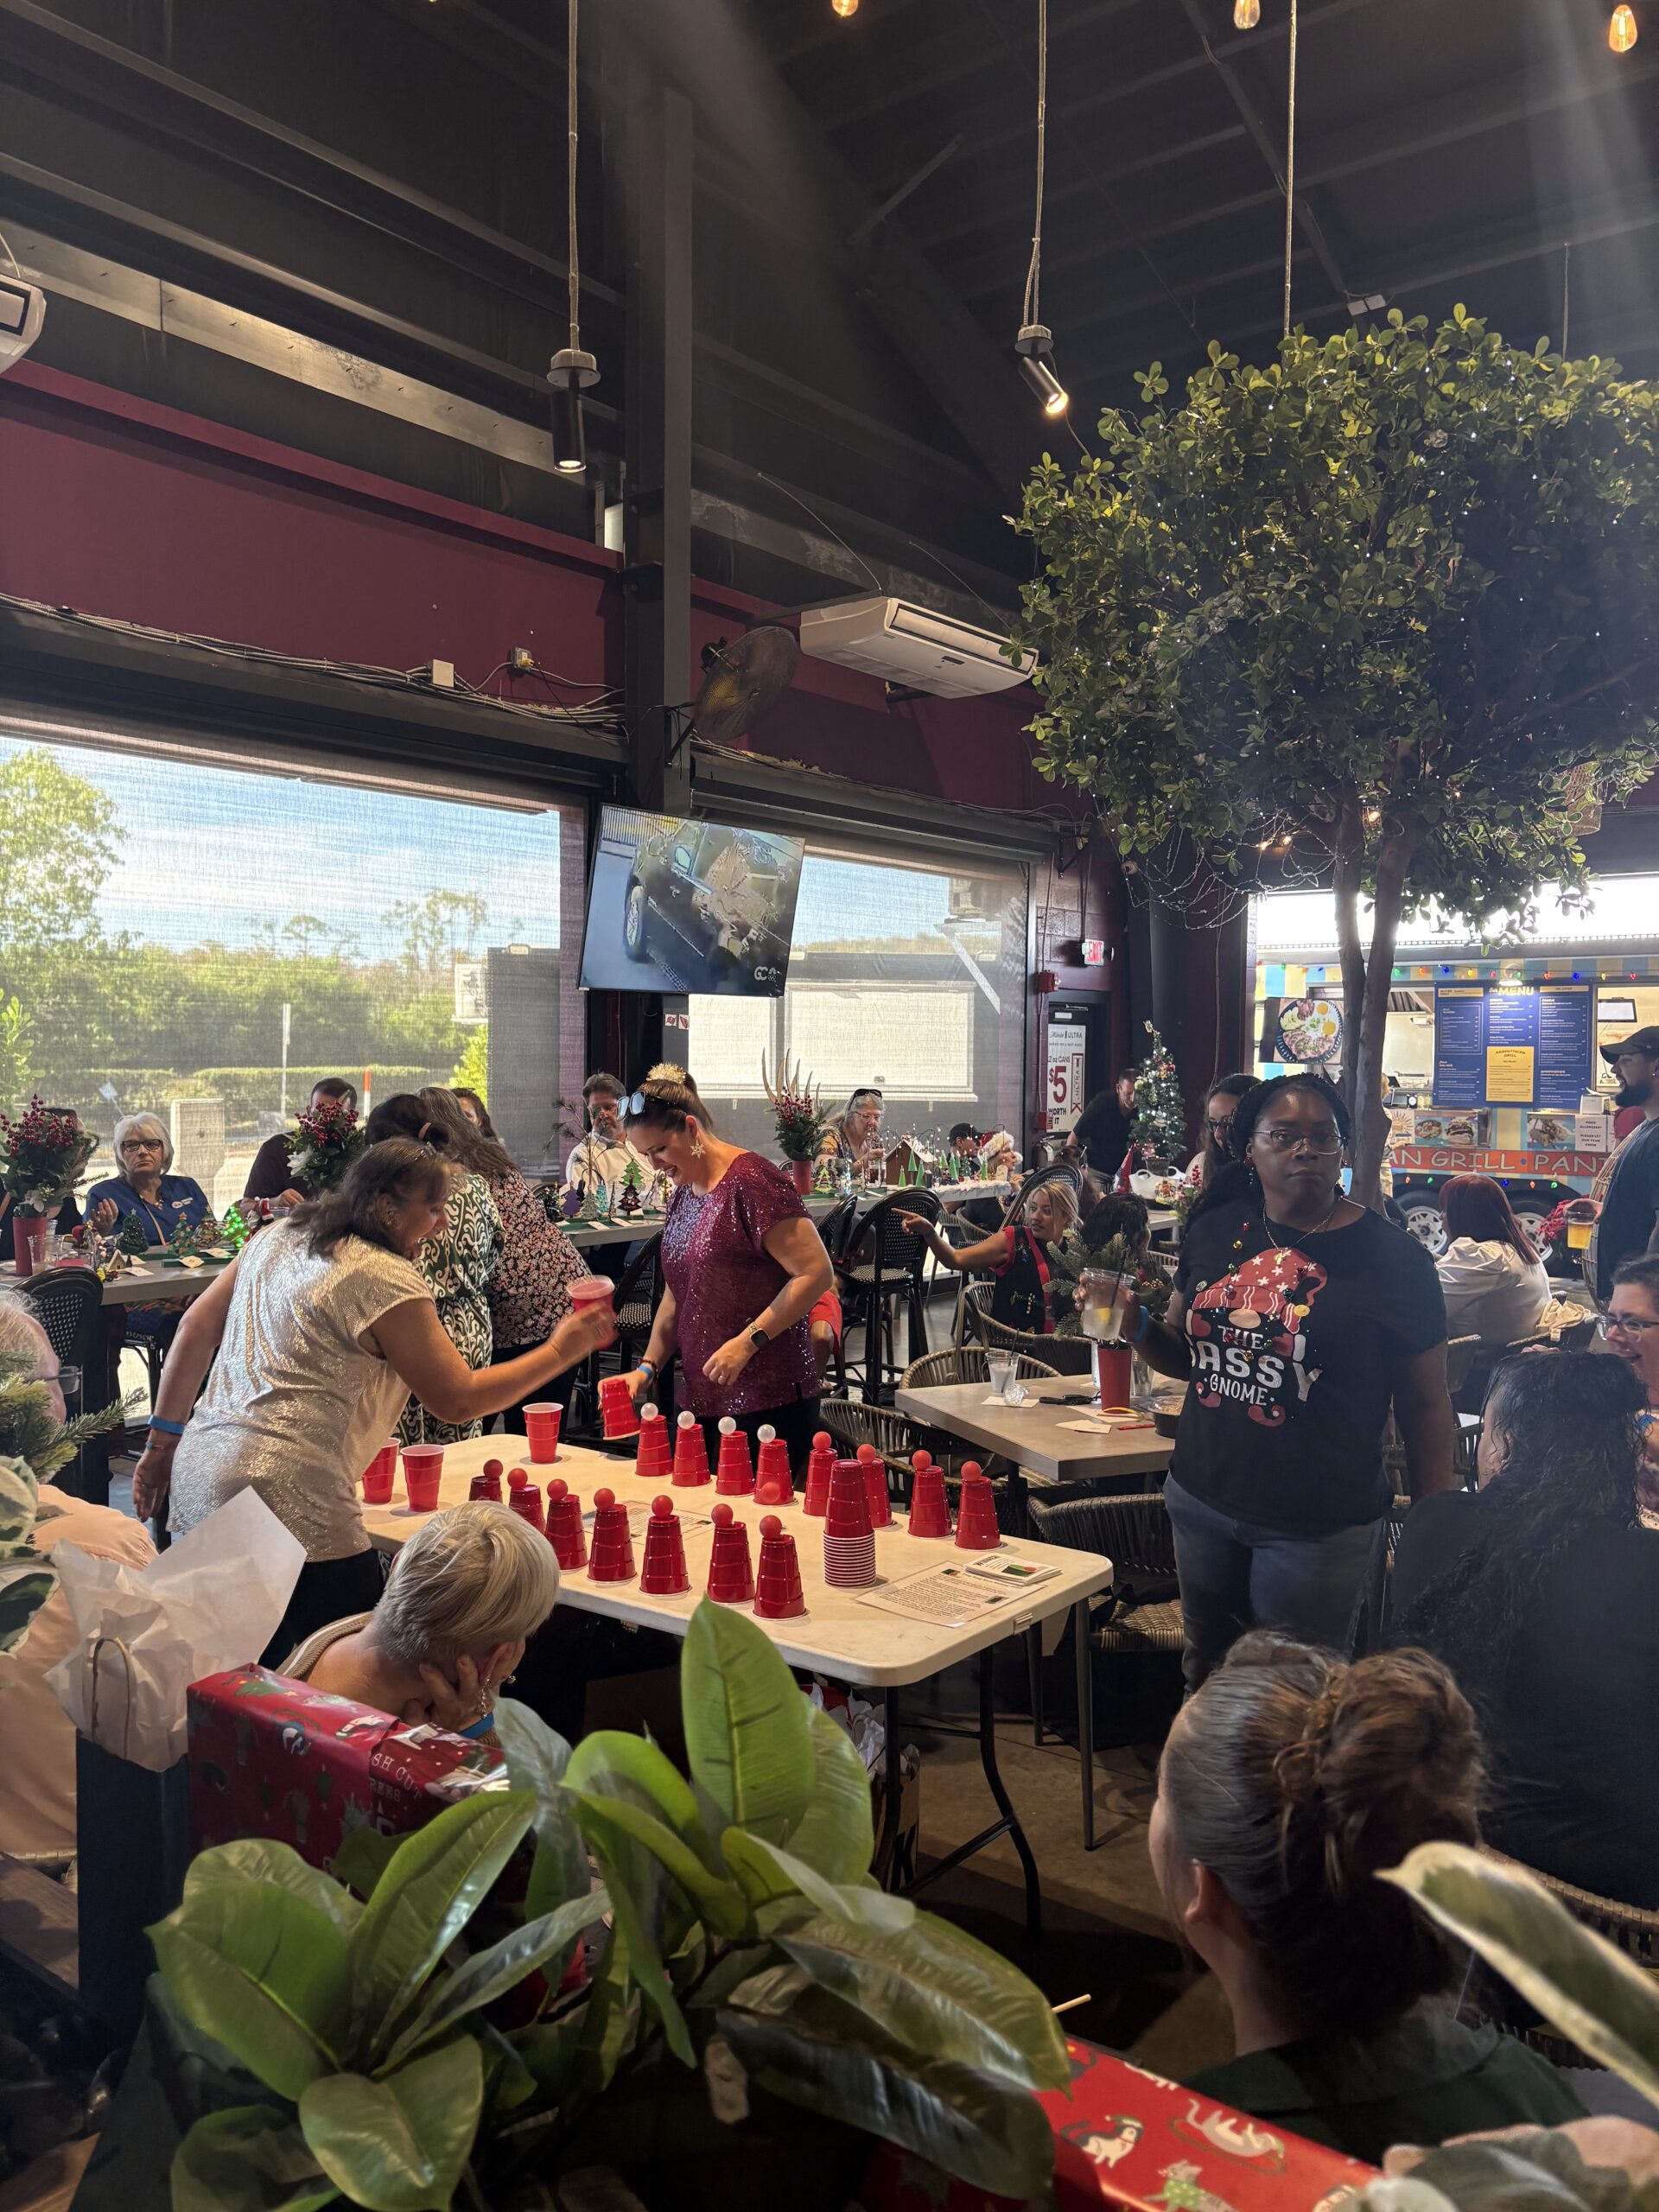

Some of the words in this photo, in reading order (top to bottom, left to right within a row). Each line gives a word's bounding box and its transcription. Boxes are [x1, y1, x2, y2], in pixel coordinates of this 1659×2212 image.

[1497, 986, 1534, 995] MENU
[1048, 1065, 1067, 1103] $5
[1431, 1150, 1516, 1170] GRILL
[1217, 1325, 1264, 1350] THE
[1210, 1373, 1268, 1406] GNOME
